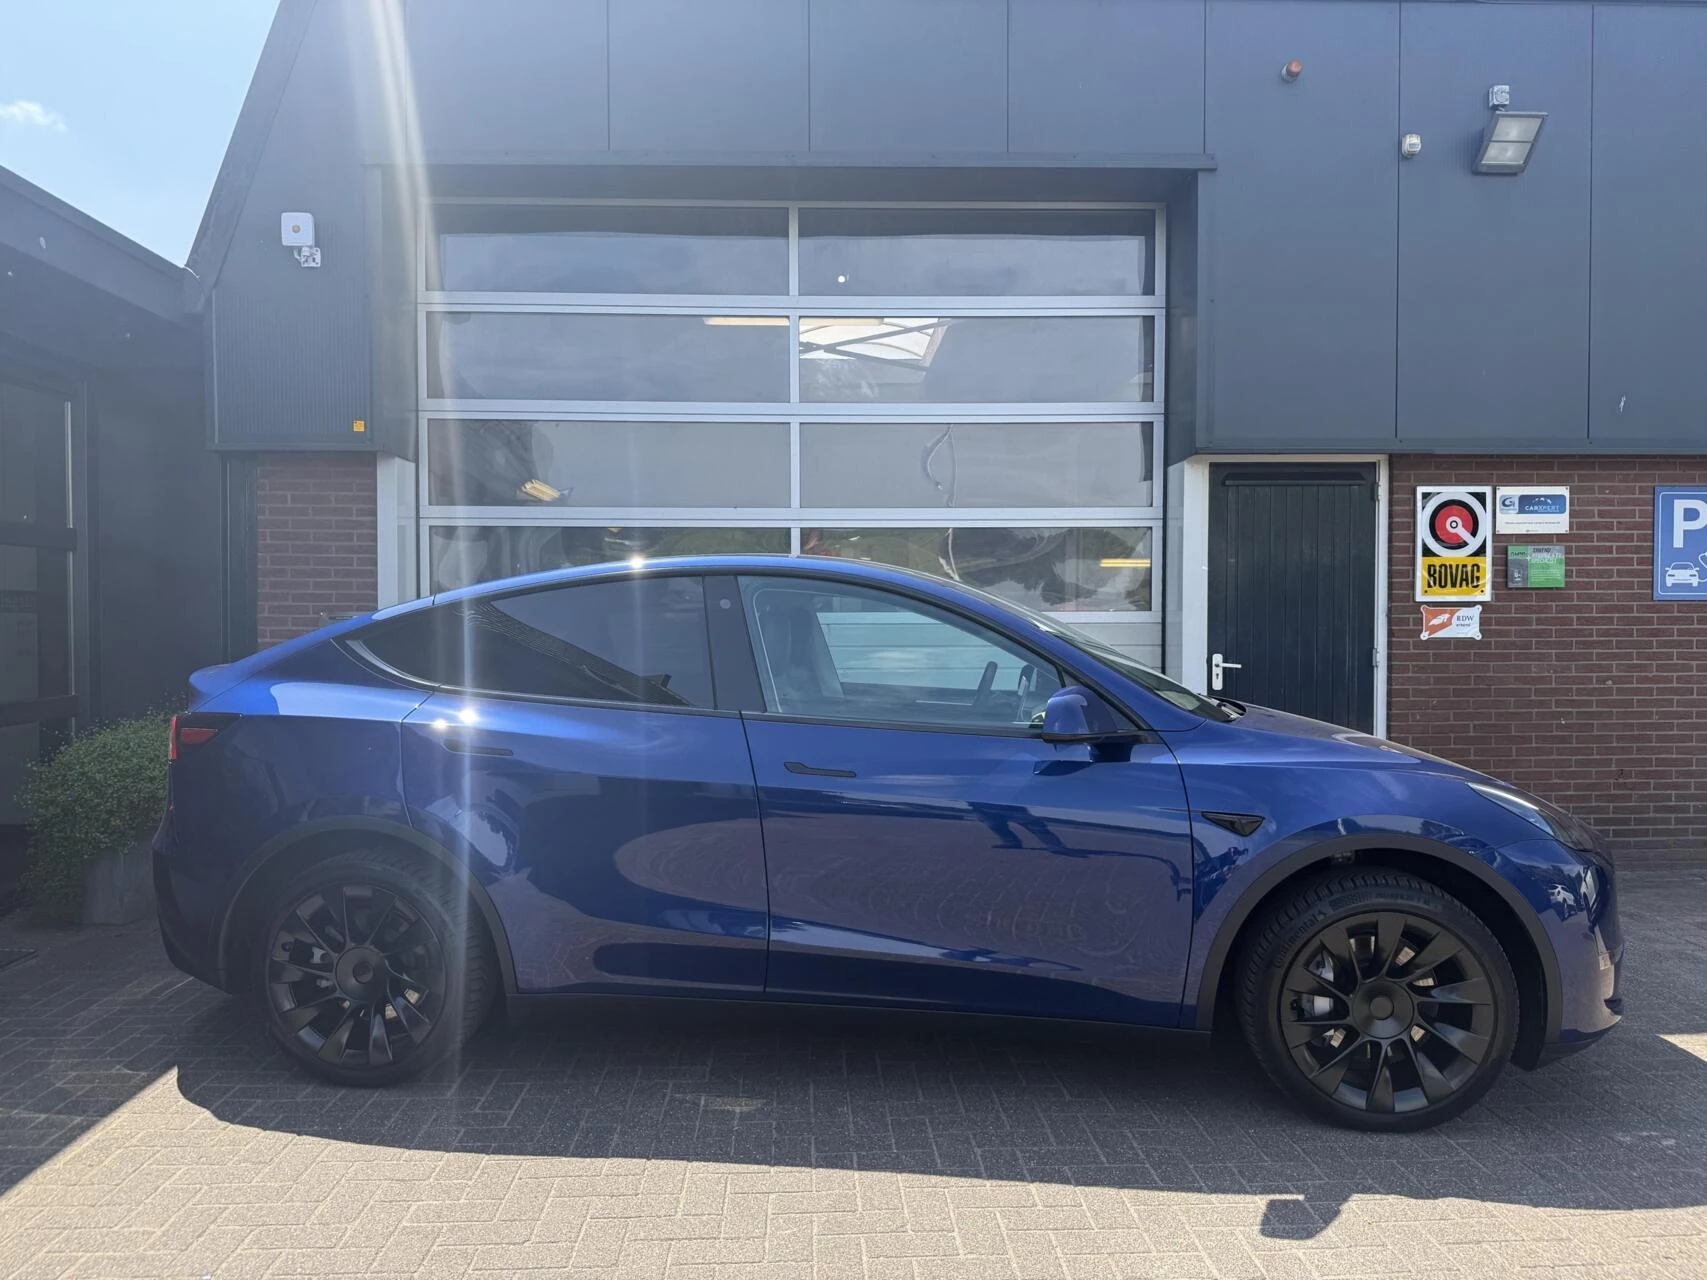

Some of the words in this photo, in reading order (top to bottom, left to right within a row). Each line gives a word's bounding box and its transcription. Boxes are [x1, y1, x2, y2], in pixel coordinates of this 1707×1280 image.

[1673, 499, 1707, 548] P
[1427, 563, 1480, 588] BOVAG
[1273, 913, 1320, 968] Continental
